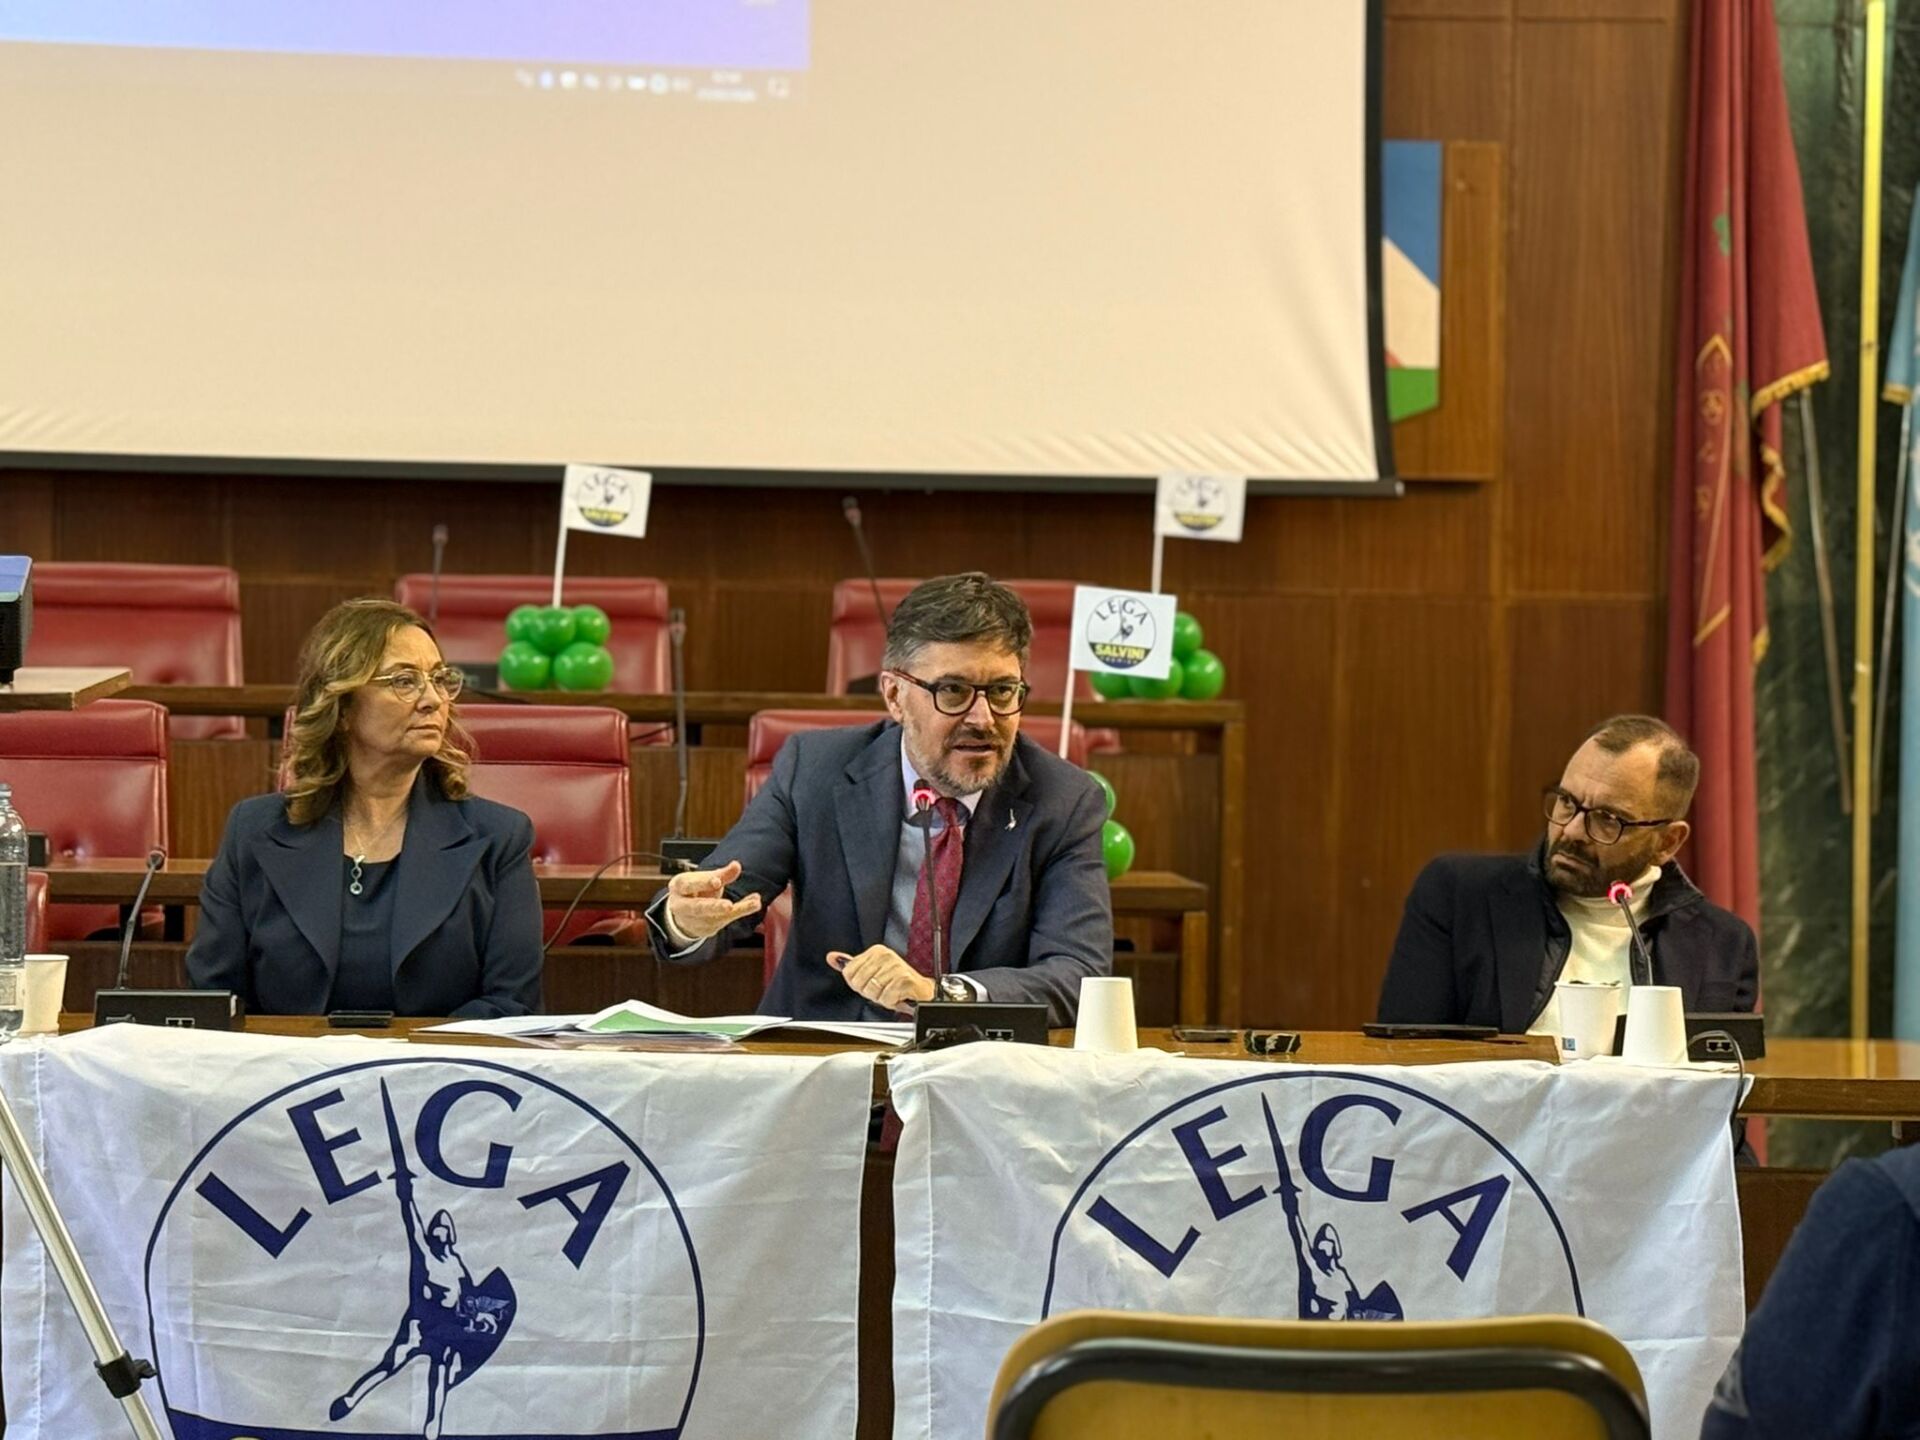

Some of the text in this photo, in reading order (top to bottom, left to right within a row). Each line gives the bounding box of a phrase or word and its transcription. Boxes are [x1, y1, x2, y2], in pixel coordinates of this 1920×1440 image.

[1095, 599, 1148, 625] LEGA
[1095, 643, 1146, 661] SALVINI
[195, 1079, 631, 1269] LEGA
[1086, 1094, 1511, 1281] LEGA
